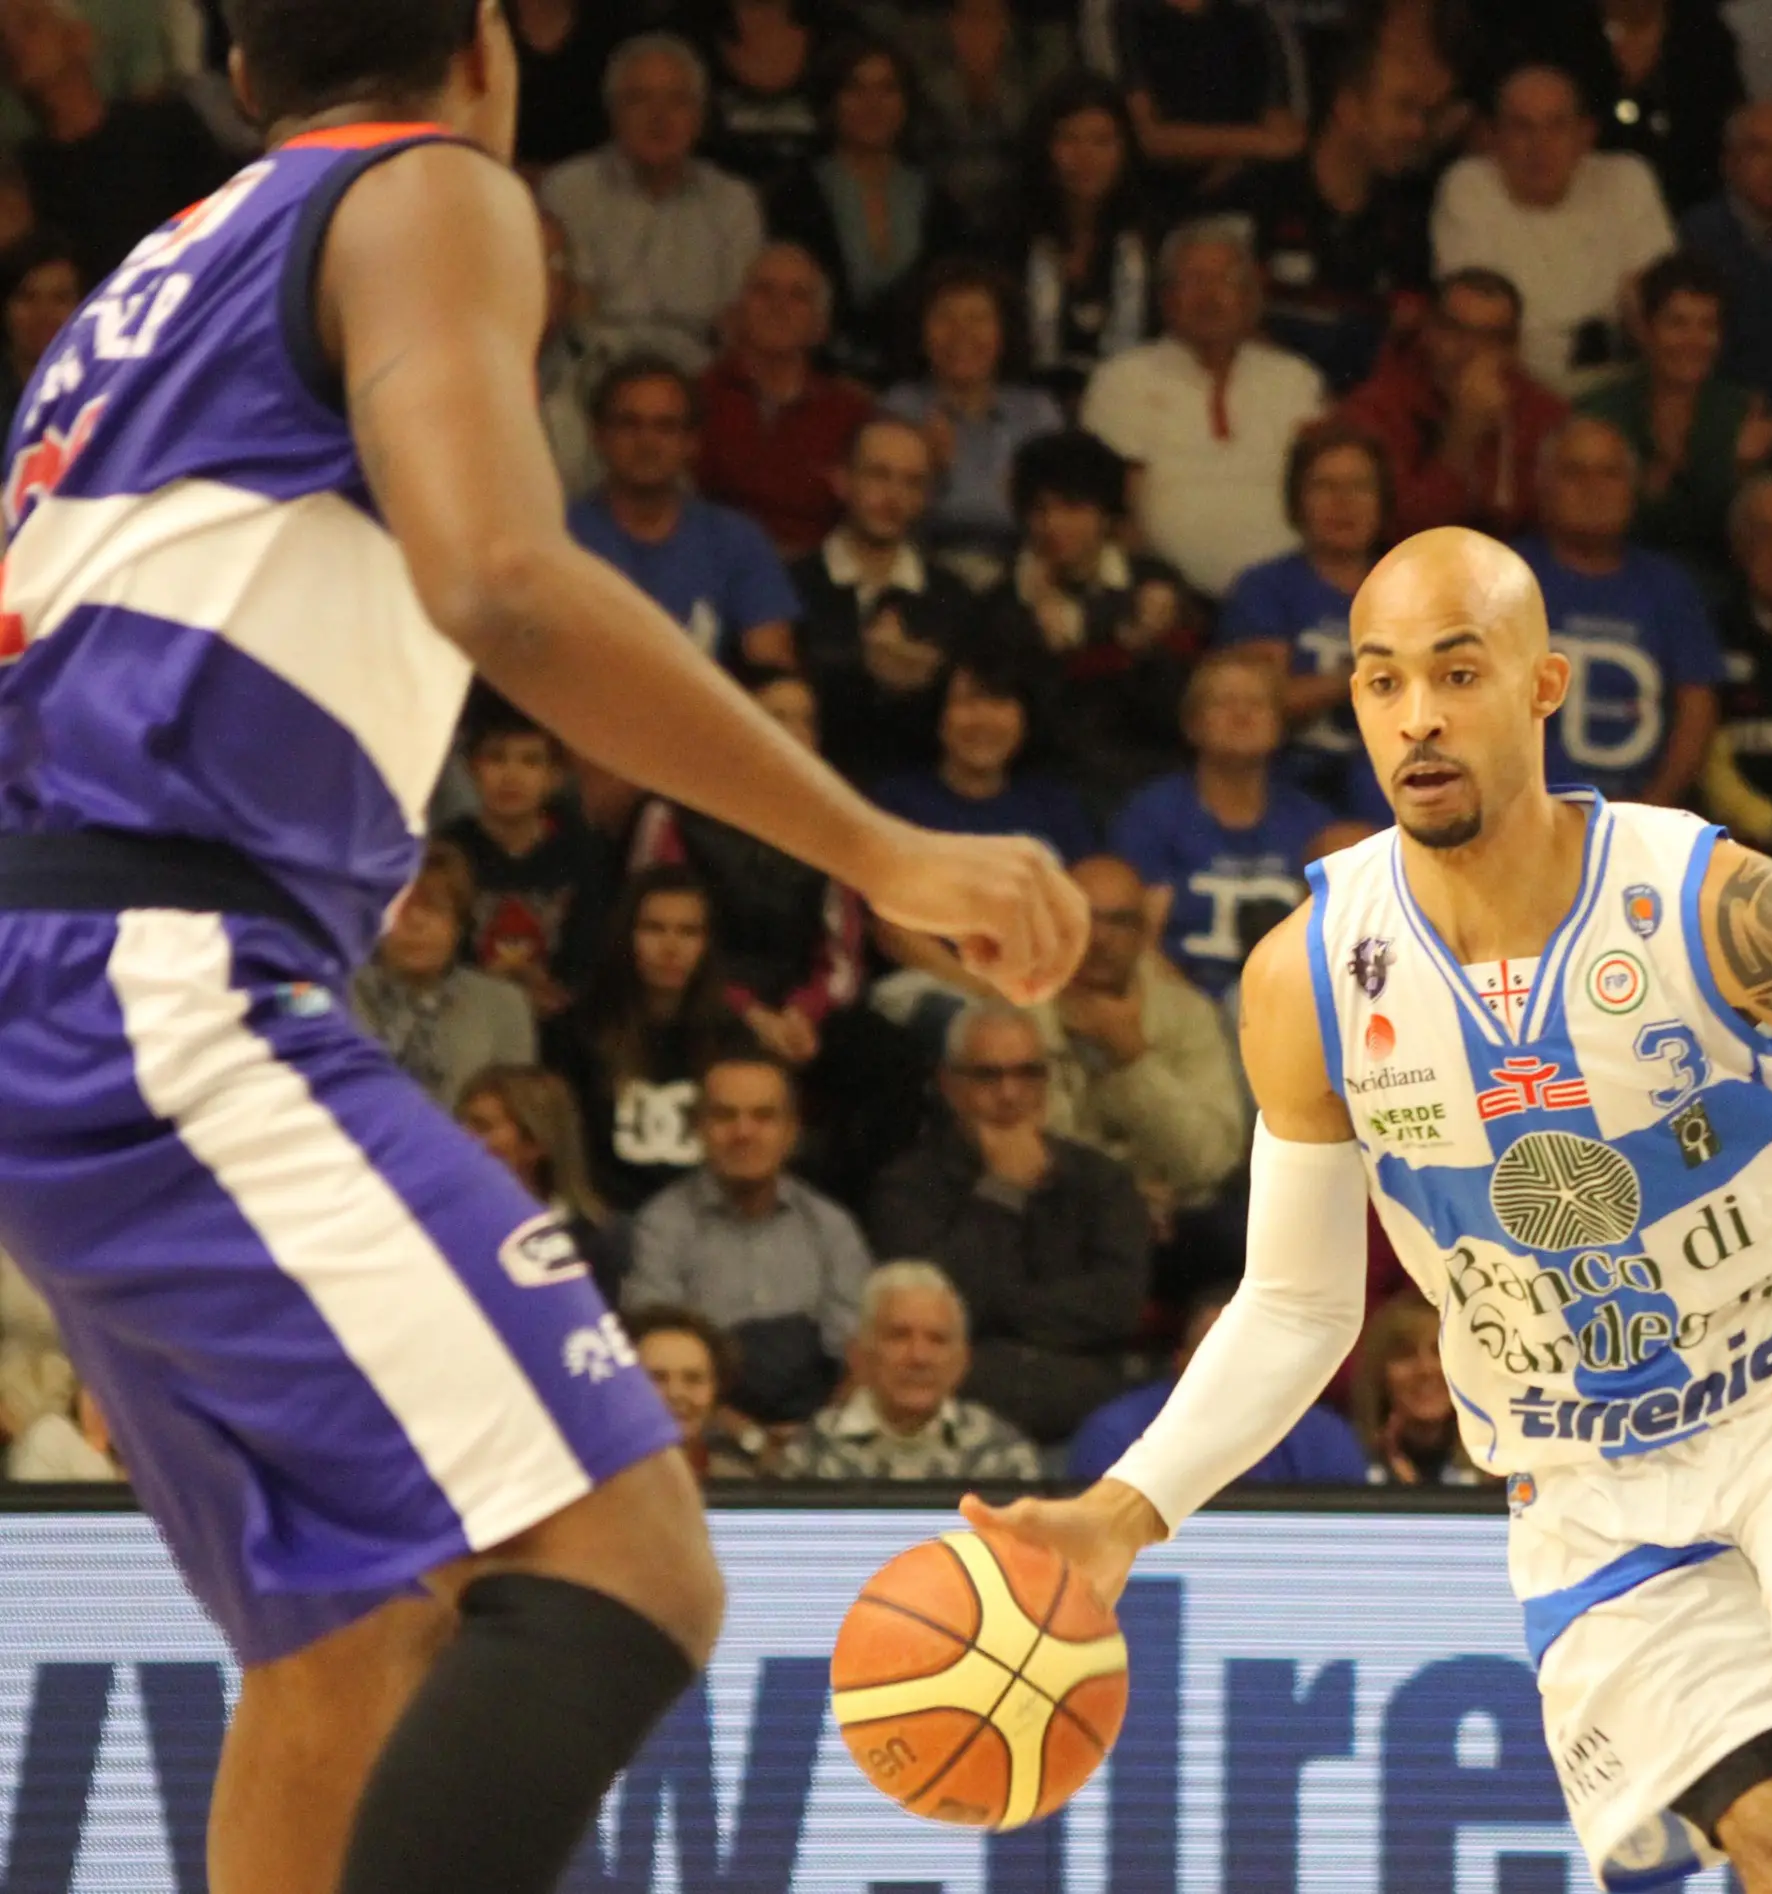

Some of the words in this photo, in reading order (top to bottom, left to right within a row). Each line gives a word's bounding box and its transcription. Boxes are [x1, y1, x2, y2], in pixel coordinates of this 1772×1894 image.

[1633, 1018, 1711, 1110] 3
[1446, 1246, 1663, 1316] Banco
[1682, 1194, 1755, 1271] di
